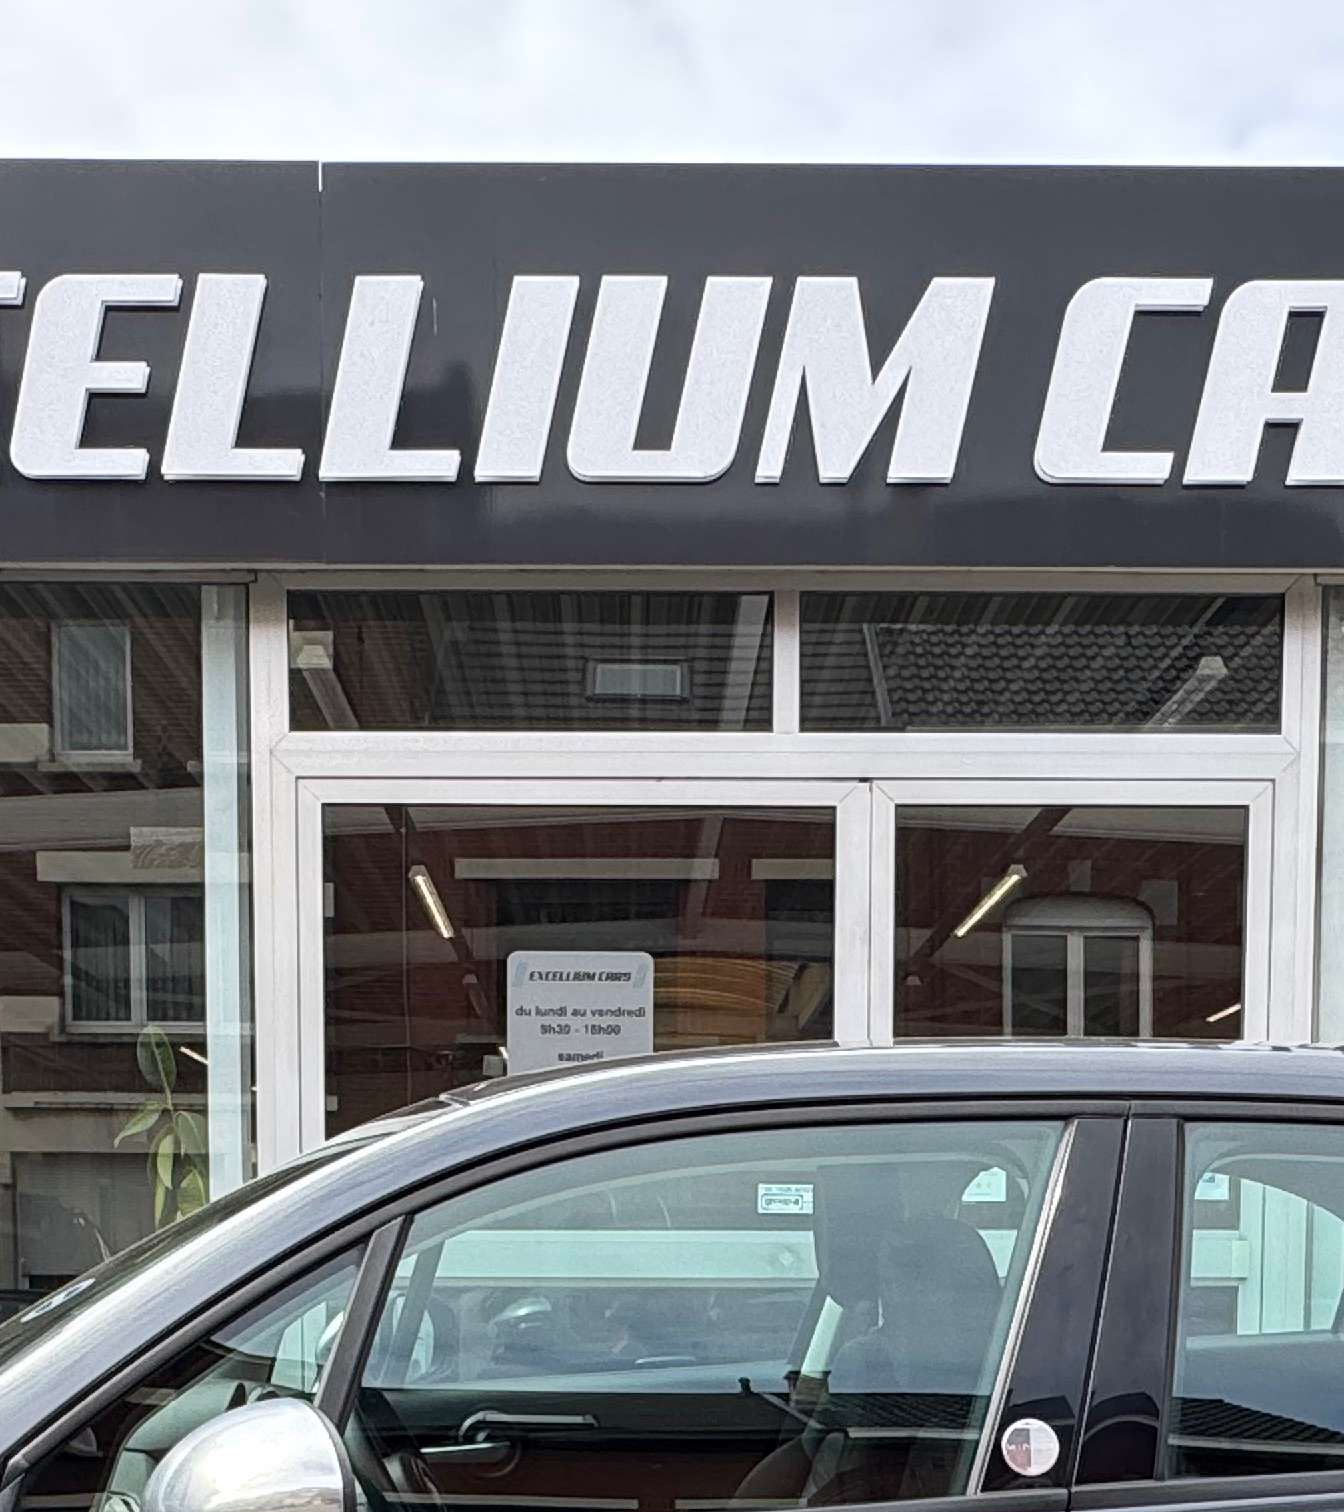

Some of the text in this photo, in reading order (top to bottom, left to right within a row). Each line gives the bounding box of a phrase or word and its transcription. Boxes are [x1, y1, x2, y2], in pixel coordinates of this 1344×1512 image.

[529, 970, 633, 982] EXCELLIUM CARS
[515, 1006, 647, 1018] du lundi au vendredi
[558, 1051, 605, 1062] samedi
